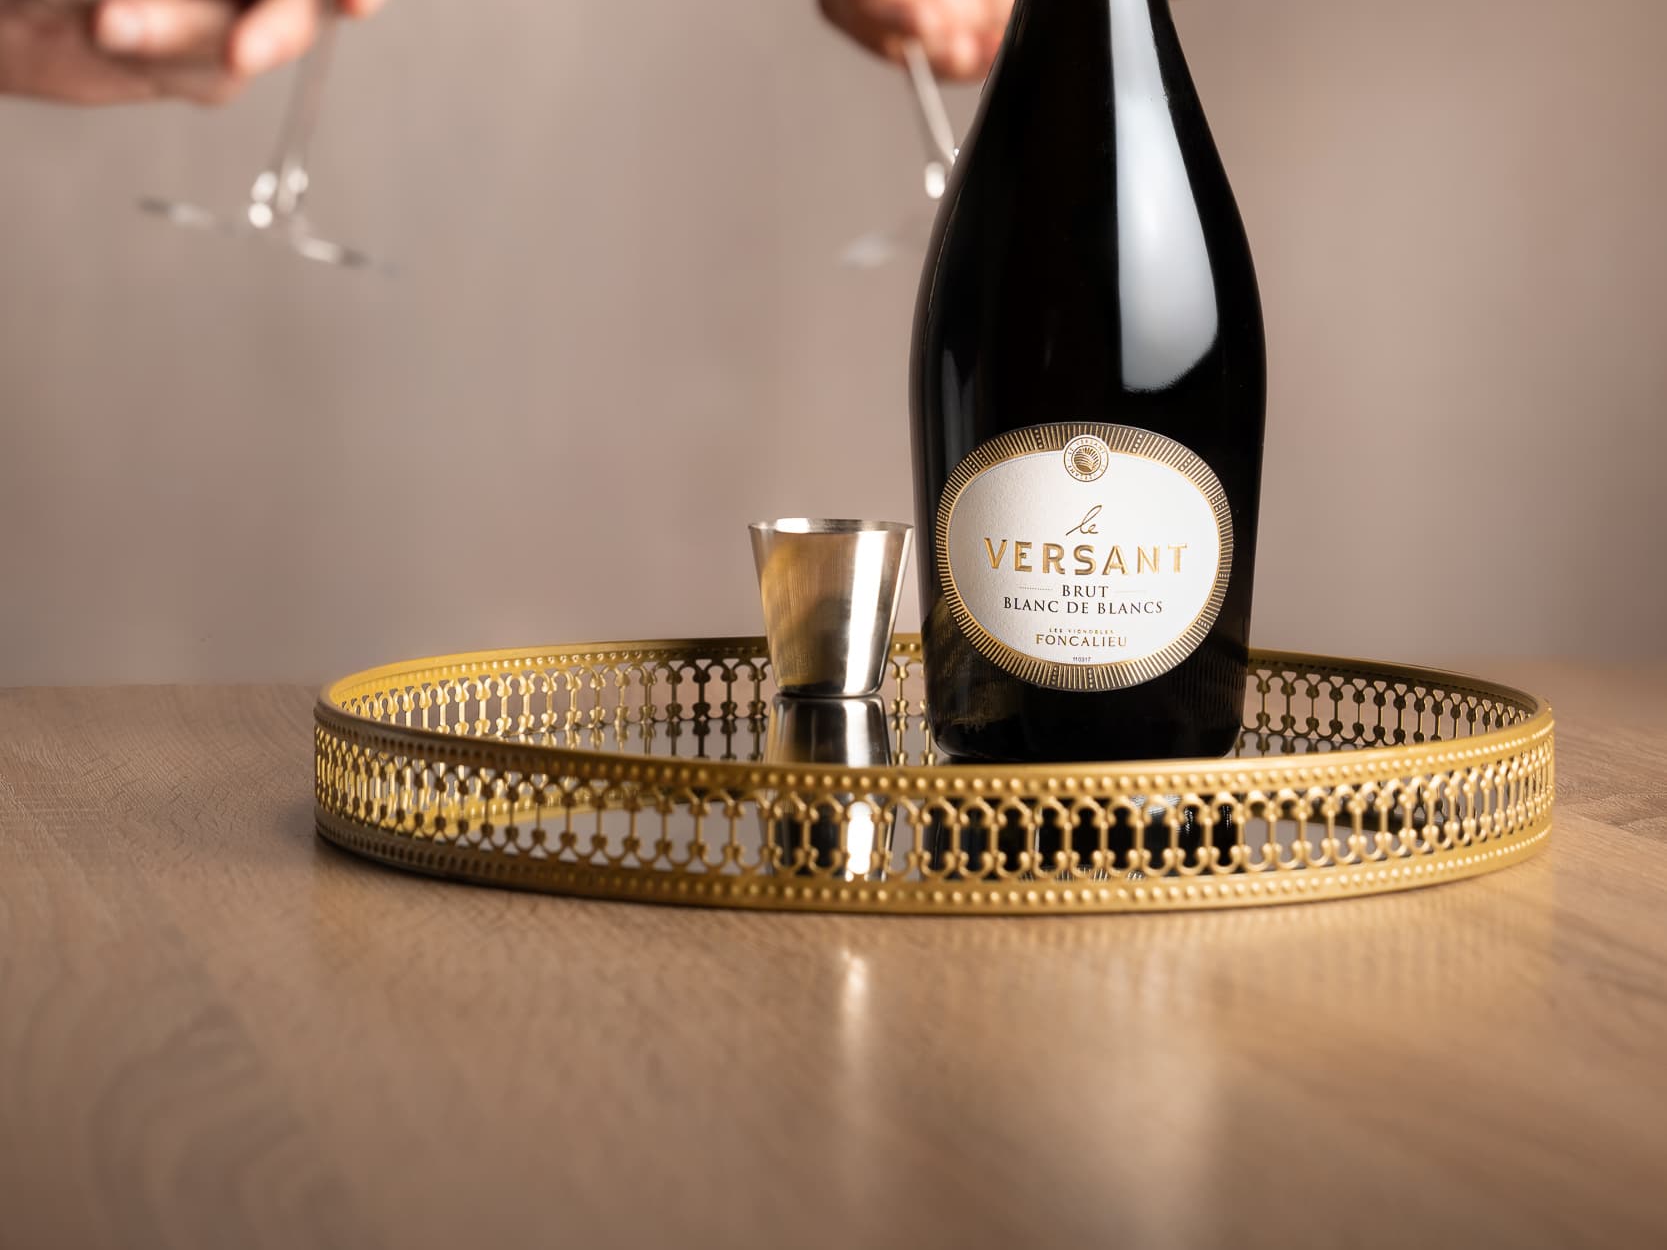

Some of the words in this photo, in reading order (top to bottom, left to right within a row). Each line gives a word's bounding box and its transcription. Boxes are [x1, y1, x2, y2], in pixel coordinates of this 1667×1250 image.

[1065, 505, 1102, 536] le
[983, 537, 1187, 575] VERSANT
[1062, 585, 1109, 598] BRUT
[1003, 597, 1059, 613] BLANC
[1066, 601, 1089, 614] DE
[1098, 601, 1163, 615] BLANCS
[1035, 634, 1127, 647] FONCALIEU
